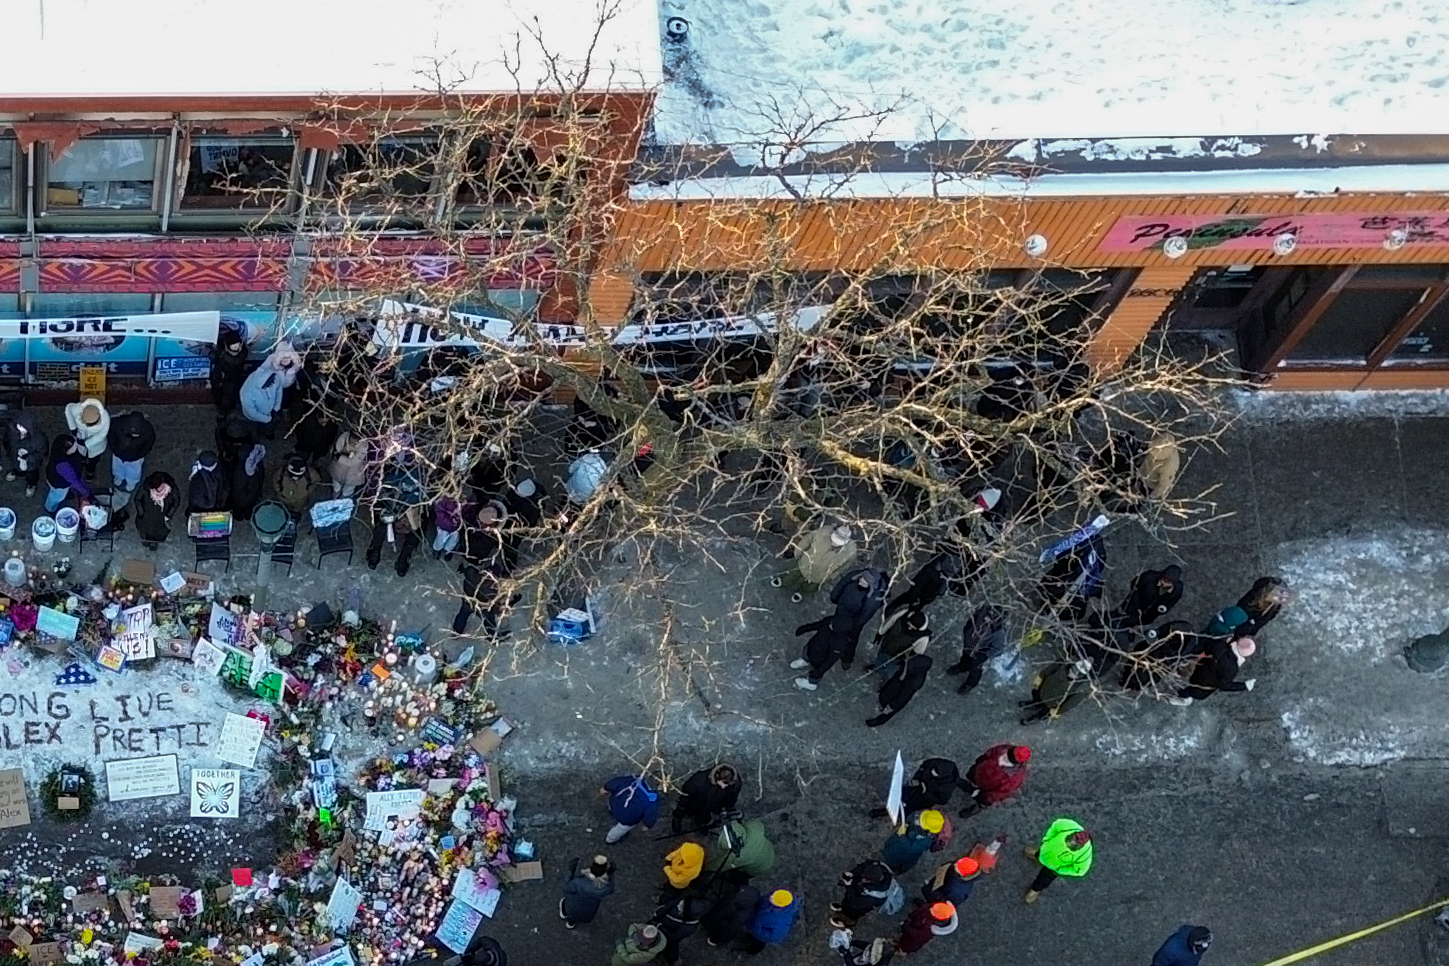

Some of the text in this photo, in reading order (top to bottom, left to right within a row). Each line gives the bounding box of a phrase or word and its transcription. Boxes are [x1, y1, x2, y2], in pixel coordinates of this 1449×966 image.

[89, 691, 174, 722] LIVE
[93, 721, 211, 755] PRETTI
[196, 770, 236, 779] TOGETHER
[0, 808, 22, 821] Alex
[36, 945, 55, 956] ICE
